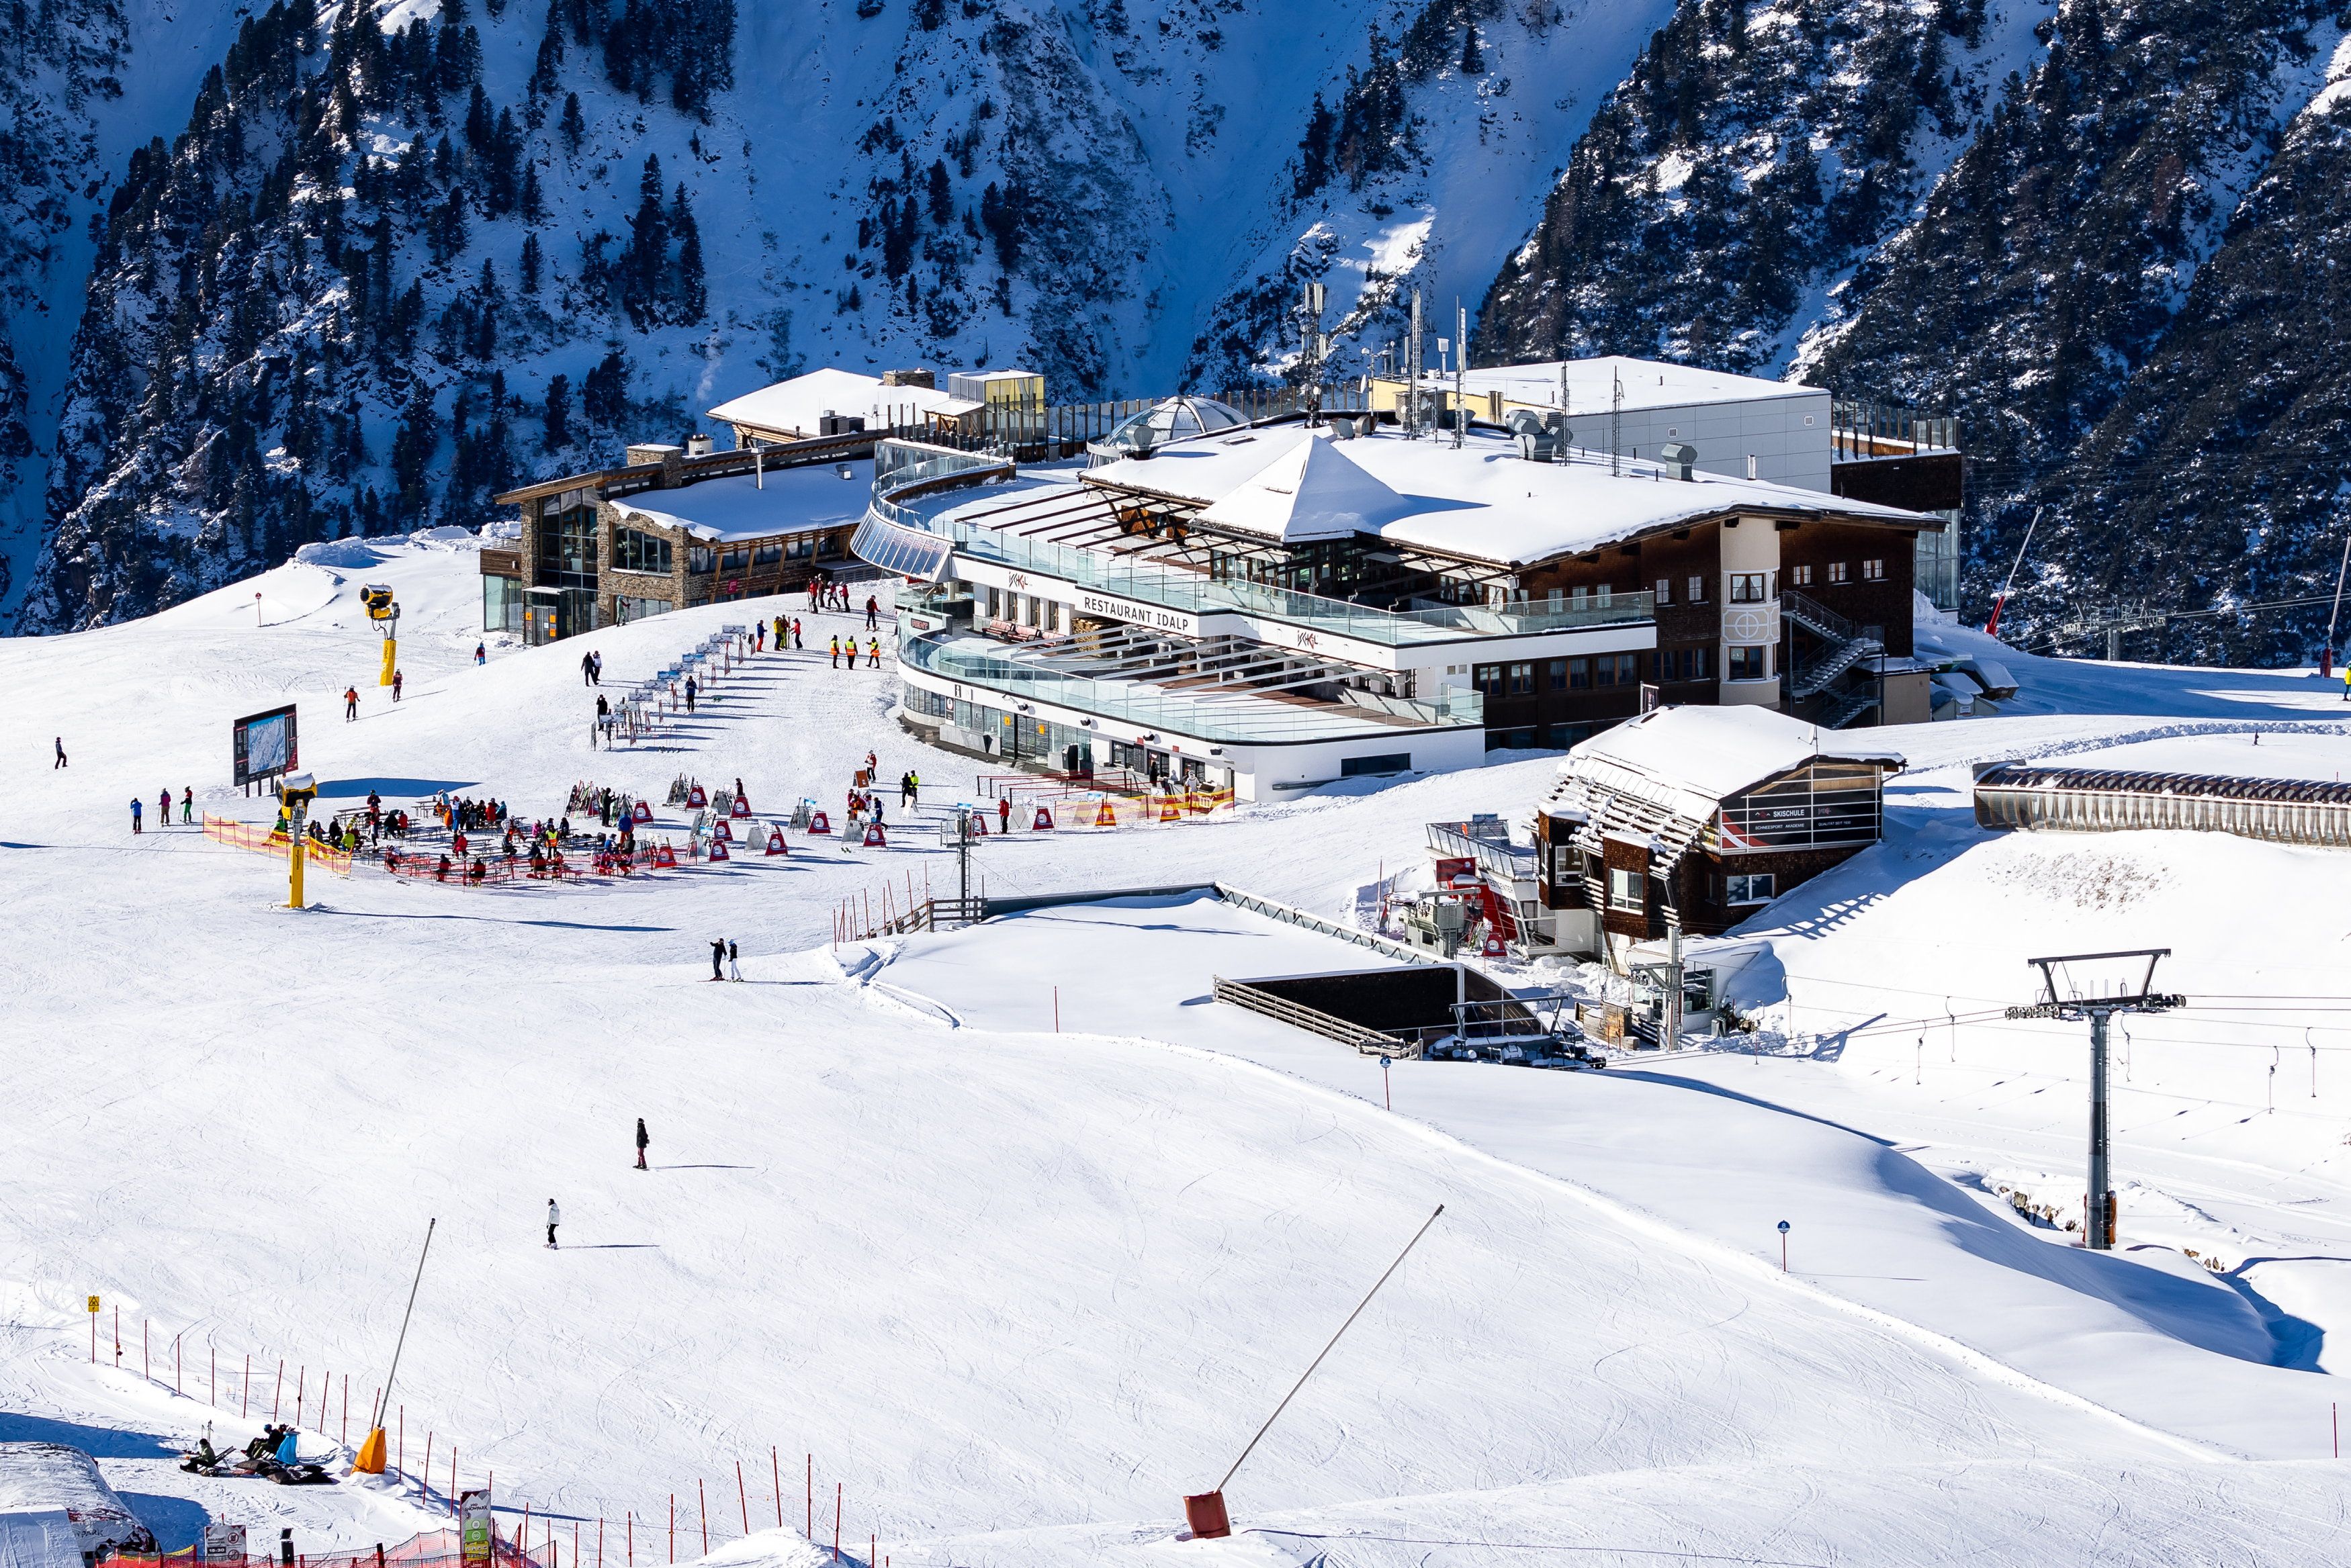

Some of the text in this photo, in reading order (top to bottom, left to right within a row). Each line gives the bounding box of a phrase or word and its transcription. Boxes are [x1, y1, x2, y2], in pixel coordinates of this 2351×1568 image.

[1084, 596, 1189, 631] RESTAURANT IDALP
[1773, 809, 1805, 818] SKISCHULE
[1487, 878, 1513, 894] TESTCENTER
